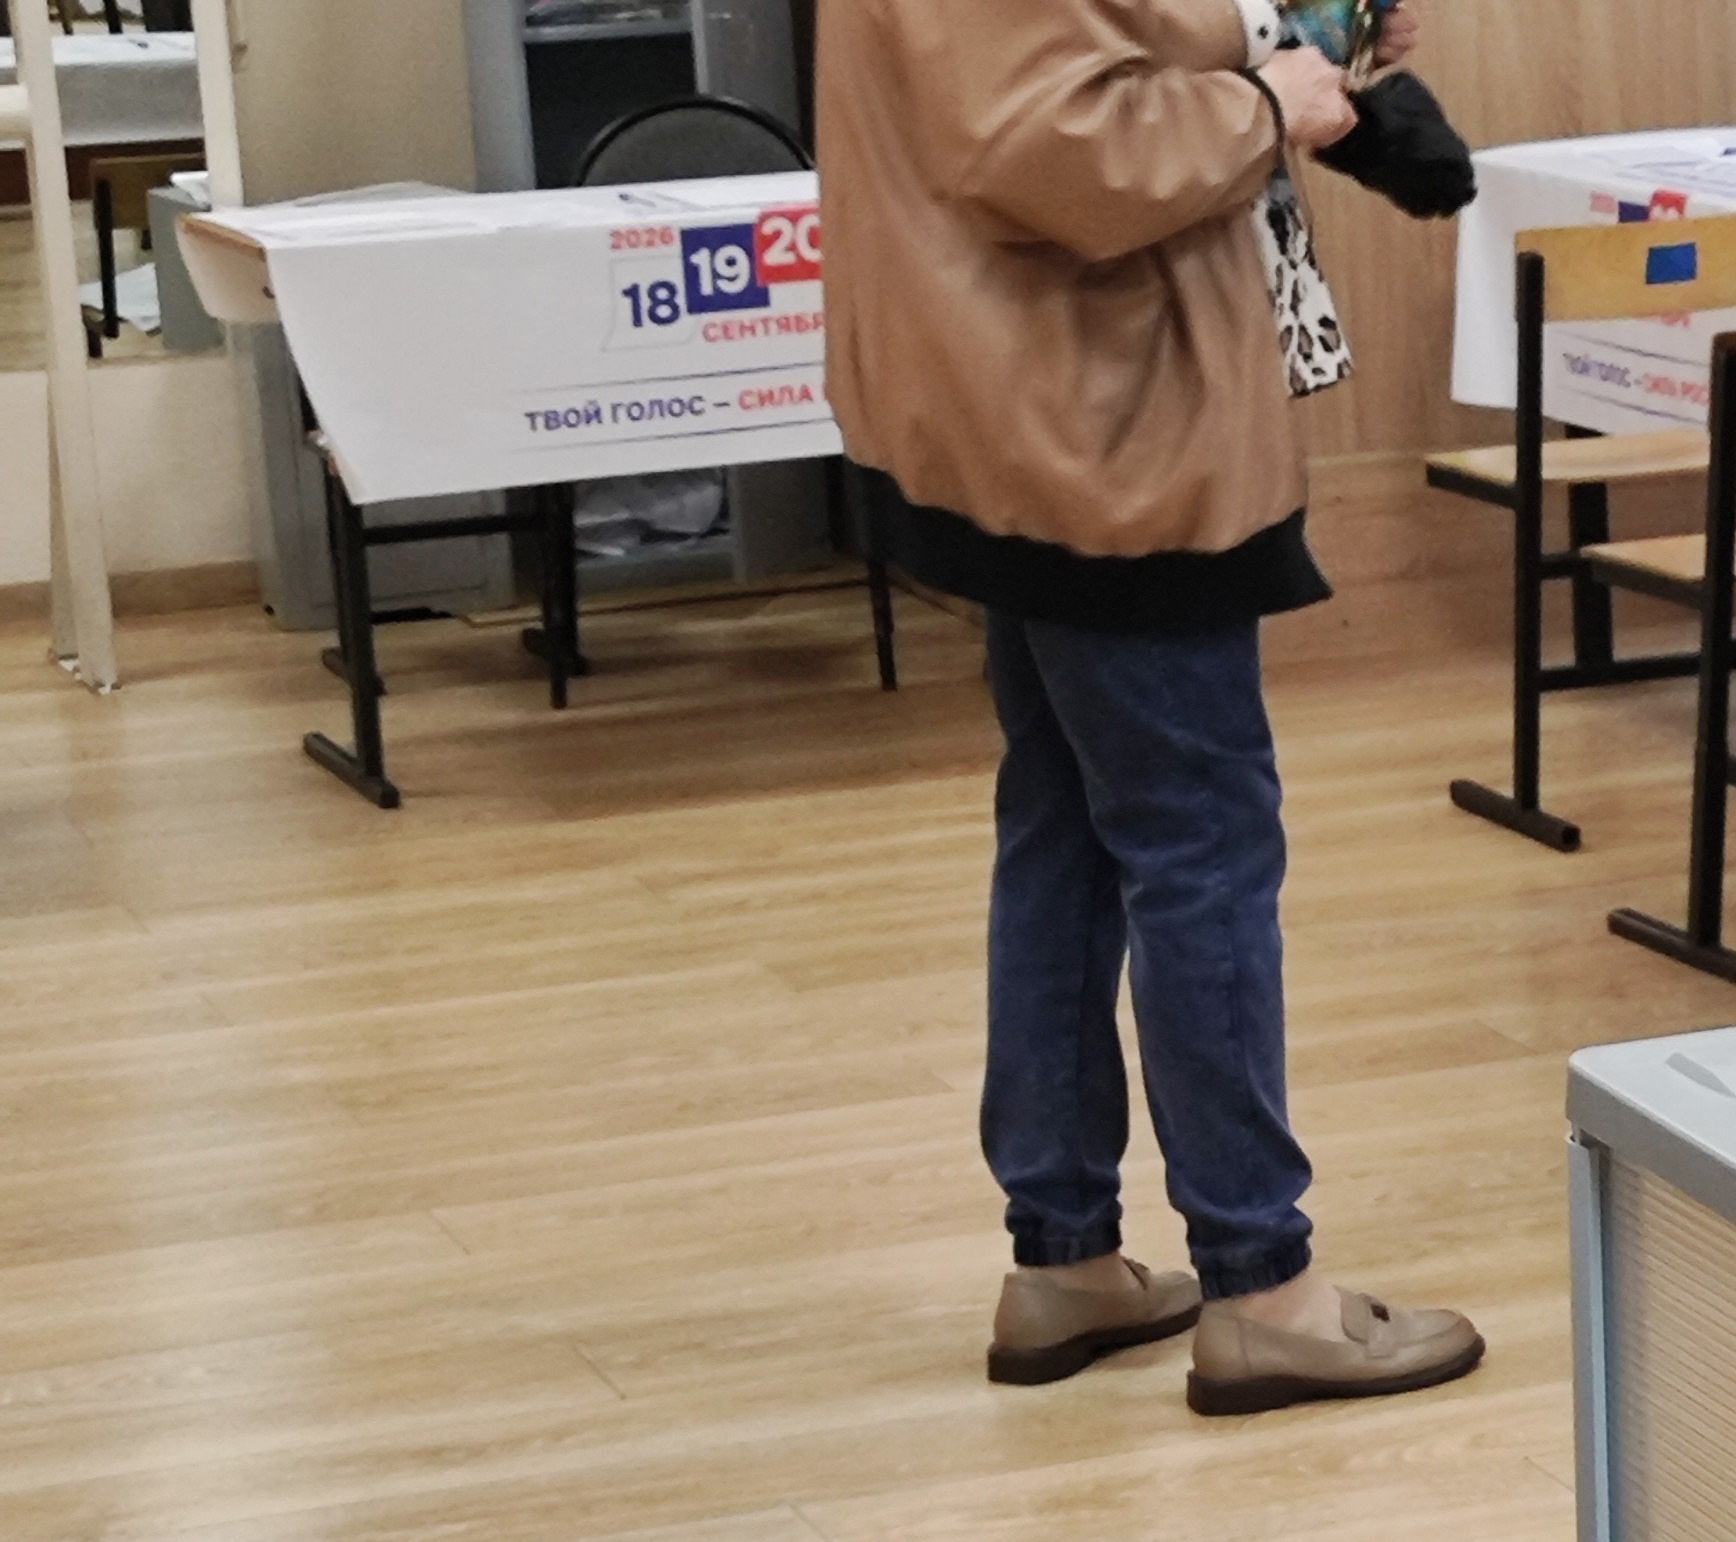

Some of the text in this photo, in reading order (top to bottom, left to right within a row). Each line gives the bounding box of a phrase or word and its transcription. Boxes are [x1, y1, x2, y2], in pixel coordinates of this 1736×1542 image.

[609, 226, 674, 250] 2026
[622, 280, 681, 327] 18
[690, 244, 751, 296] 19
[703, 312, 825, 342] СЕНТЯБР
[525, 401, 603, 432] ТВОЙ
[611, 395, 706, 424] ГОЛОС
[738, 384, 813, 410] СИЛА
